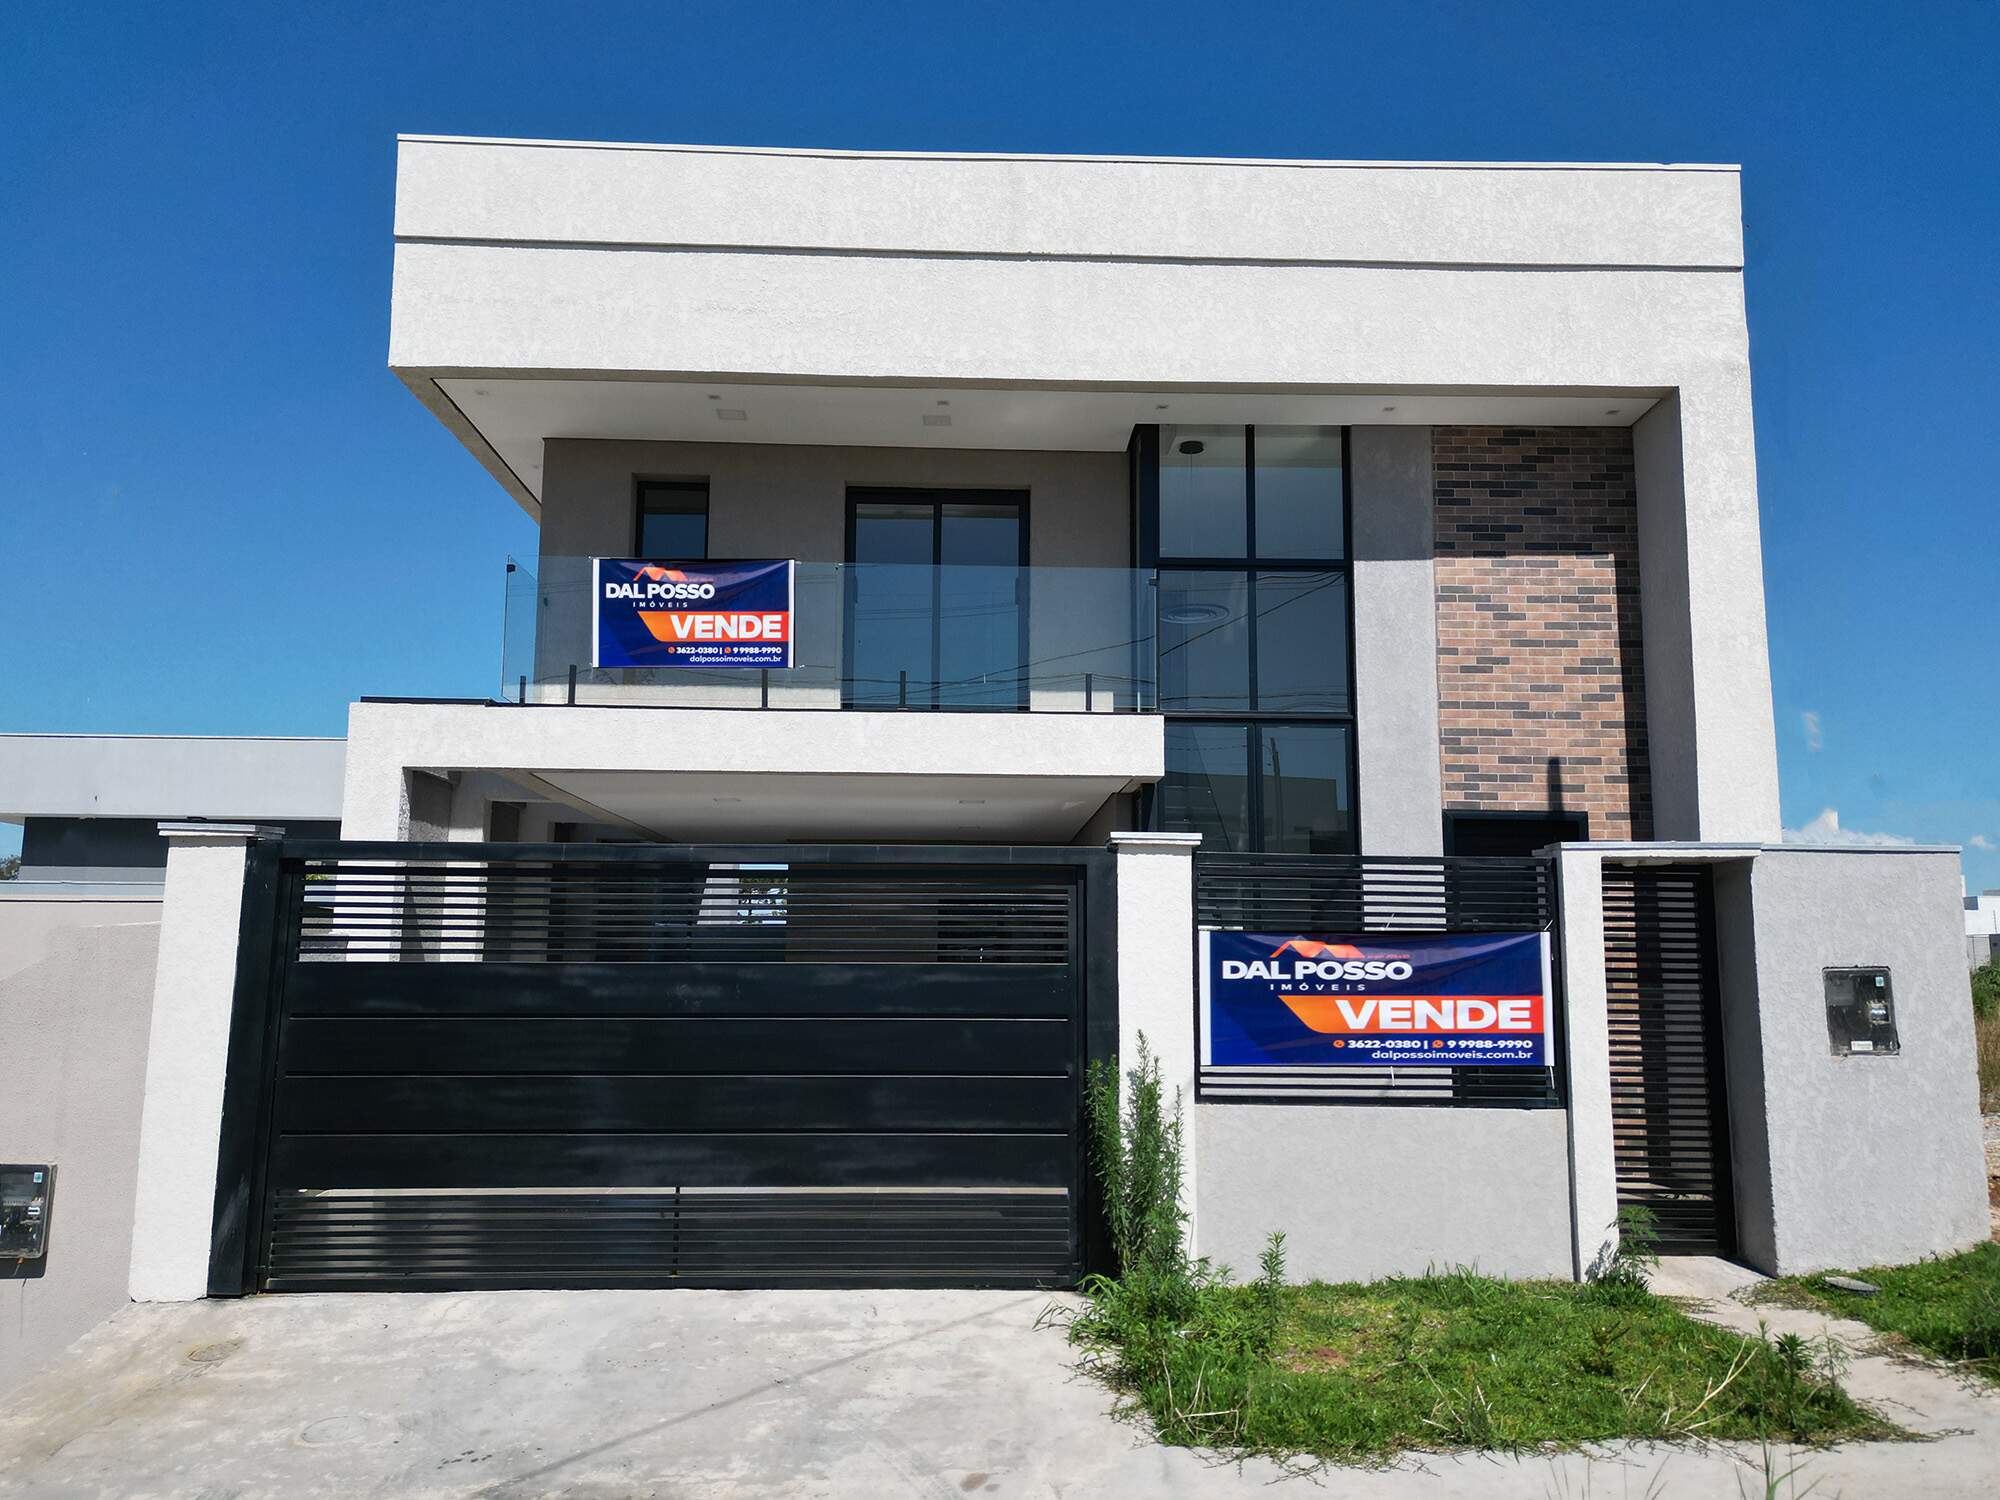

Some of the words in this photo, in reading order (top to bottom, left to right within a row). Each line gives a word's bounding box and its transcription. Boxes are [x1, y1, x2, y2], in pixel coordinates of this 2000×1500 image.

[605, 583, 645, 599] DAL
[647, 583, 715, 599] POSSO
[669, 614, 782, 639] VENDE
[689, 655, 782, 663] dalpossoimoveis.com.br
[1221, 960, 1291, 980] DAL
[1294, 960, 1413, 980] POSSO
[1270, 982, 1366, 991] IMÓVEIS
[1334, 999, 1532, 1030] VENDE
[1347, 1040, 1421, 1049] 3622-0380
[1447, 1040, 1456, 1049] 9
[1458, 1040, 1533, 1049] 9988-9990
[1371, 1050, 1533, 1061] dalpossoimoveis.com.br
